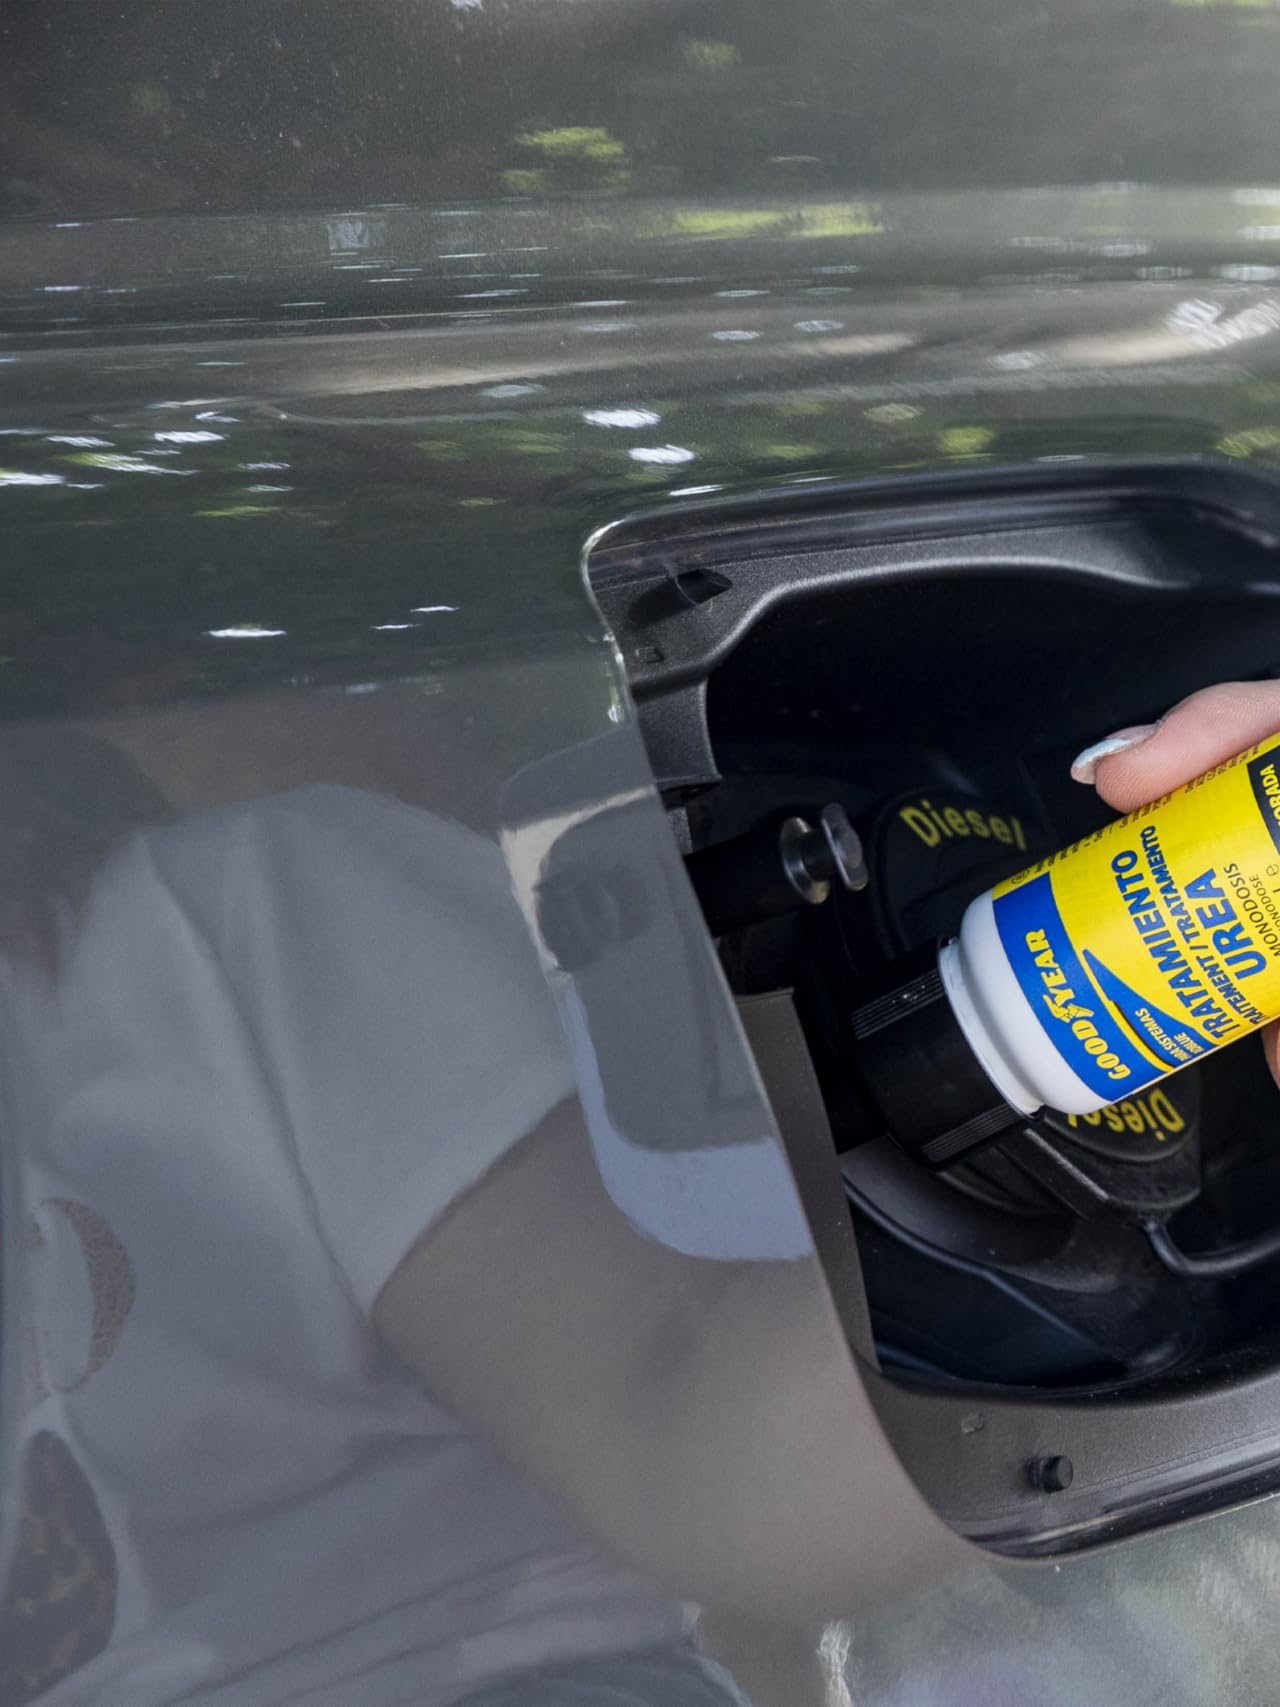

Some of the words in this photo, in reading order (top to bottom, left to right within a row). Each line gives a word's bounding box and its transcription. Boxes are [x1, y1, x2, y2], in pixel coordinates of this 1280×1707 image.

[899, 798, 1027, 852] Diesel
[1140, 825, 1200, 943] TRATAMENTO
[1184, 868, 1267, 979] UREA
[1110, 849, 1240, 1039] TRATAMIENTO
[1025, 928, 1131, 1080] GOODYEAR
[1135, 1008, 1176, 1050] SISTEMAS
